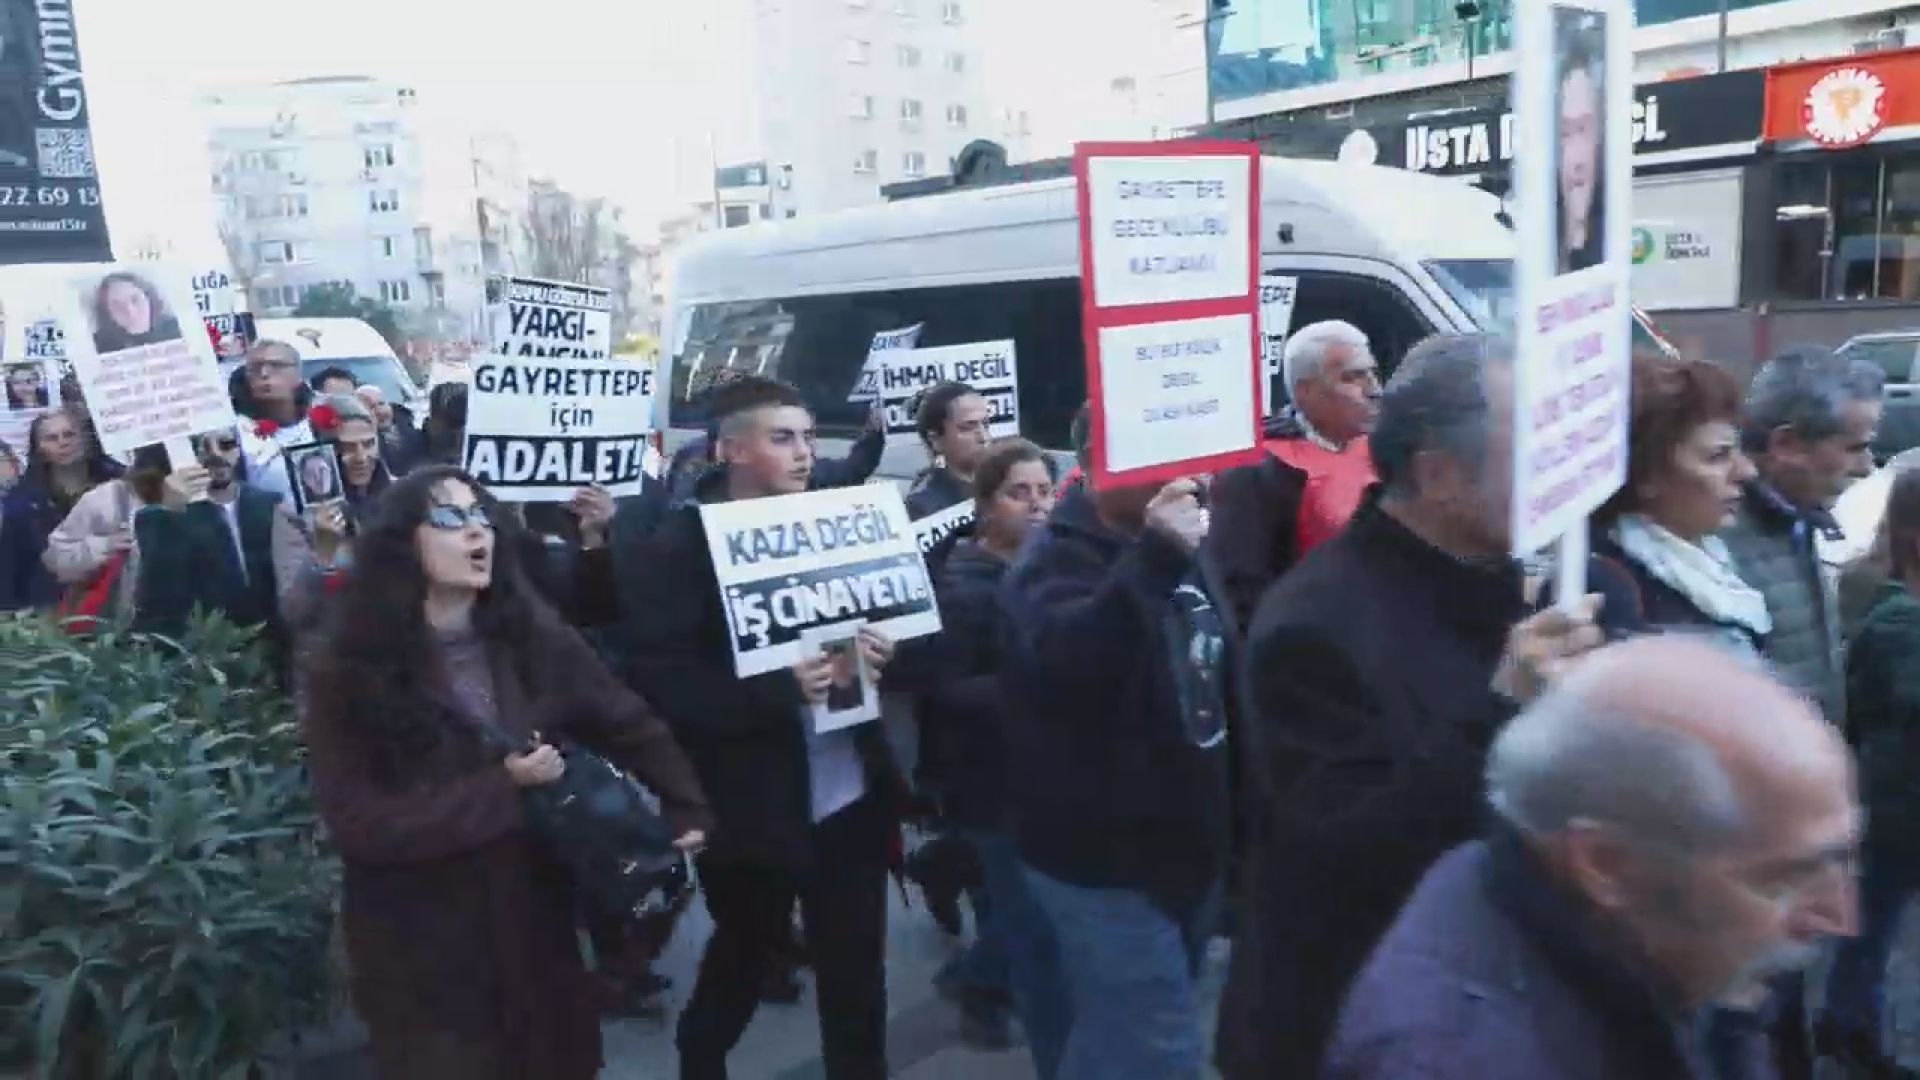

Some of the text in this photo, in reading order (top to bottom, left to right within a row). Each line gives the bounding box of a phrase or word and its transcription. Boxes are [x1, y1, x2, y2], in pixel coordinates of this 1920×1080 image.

[1406, 122, 1490, 171] USTA
[38, 186, 70, 206] 69
[509, 303, 596, 342] YARGI-
[475, 365, 652, 397] GAYRETTEPE
[954, 352, 1011, 382] DEĞİL
[551, 402, 593, 432] için
[467, 439, 641, 482] ADALET!
[726, 503, 899, 566] KAZA DEĞİL
[728, 587, 770, 648] İŞ
